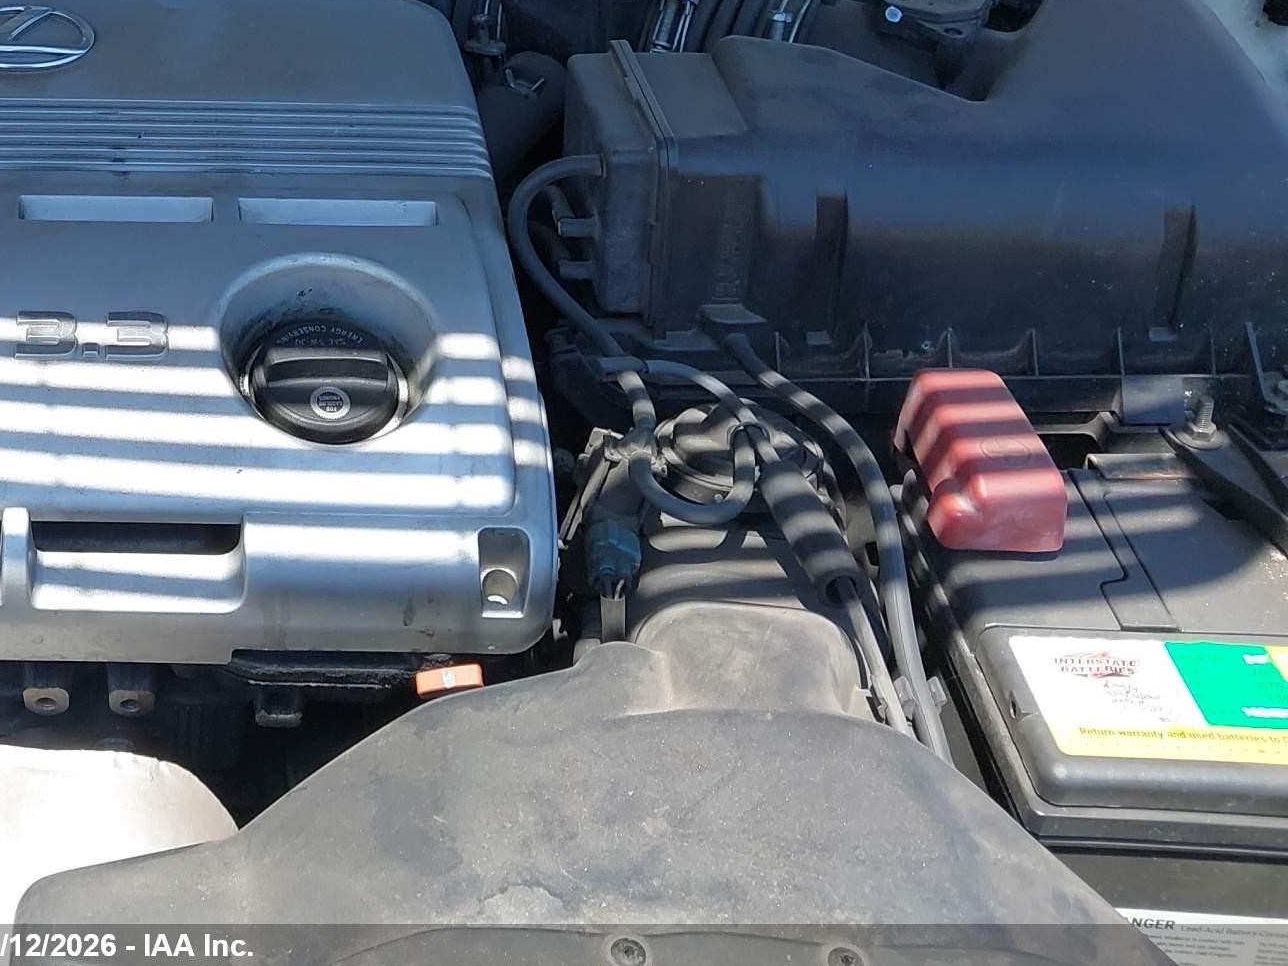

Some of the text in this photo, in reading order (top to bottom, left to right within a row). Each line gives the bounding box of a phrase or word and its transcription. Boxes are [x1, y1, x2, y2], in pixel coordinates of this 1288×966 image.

[13, 310, 170, 361] 3.3
[1054, 657, 1136, 667] INTERSTATE
[1060, 665, 1135, 675] BATTERIES
[1079, 726, 1115, 737] Return
[1119, 730, 1163, 740] warranty
[1168, 729, 1186, 739] and
[1189, 730, 1215, 740] used
[1218, 731, 1267, 743] batteries
[1270, 735, 1281, 744] to
[1132, 917, 1176, 931] NGER
